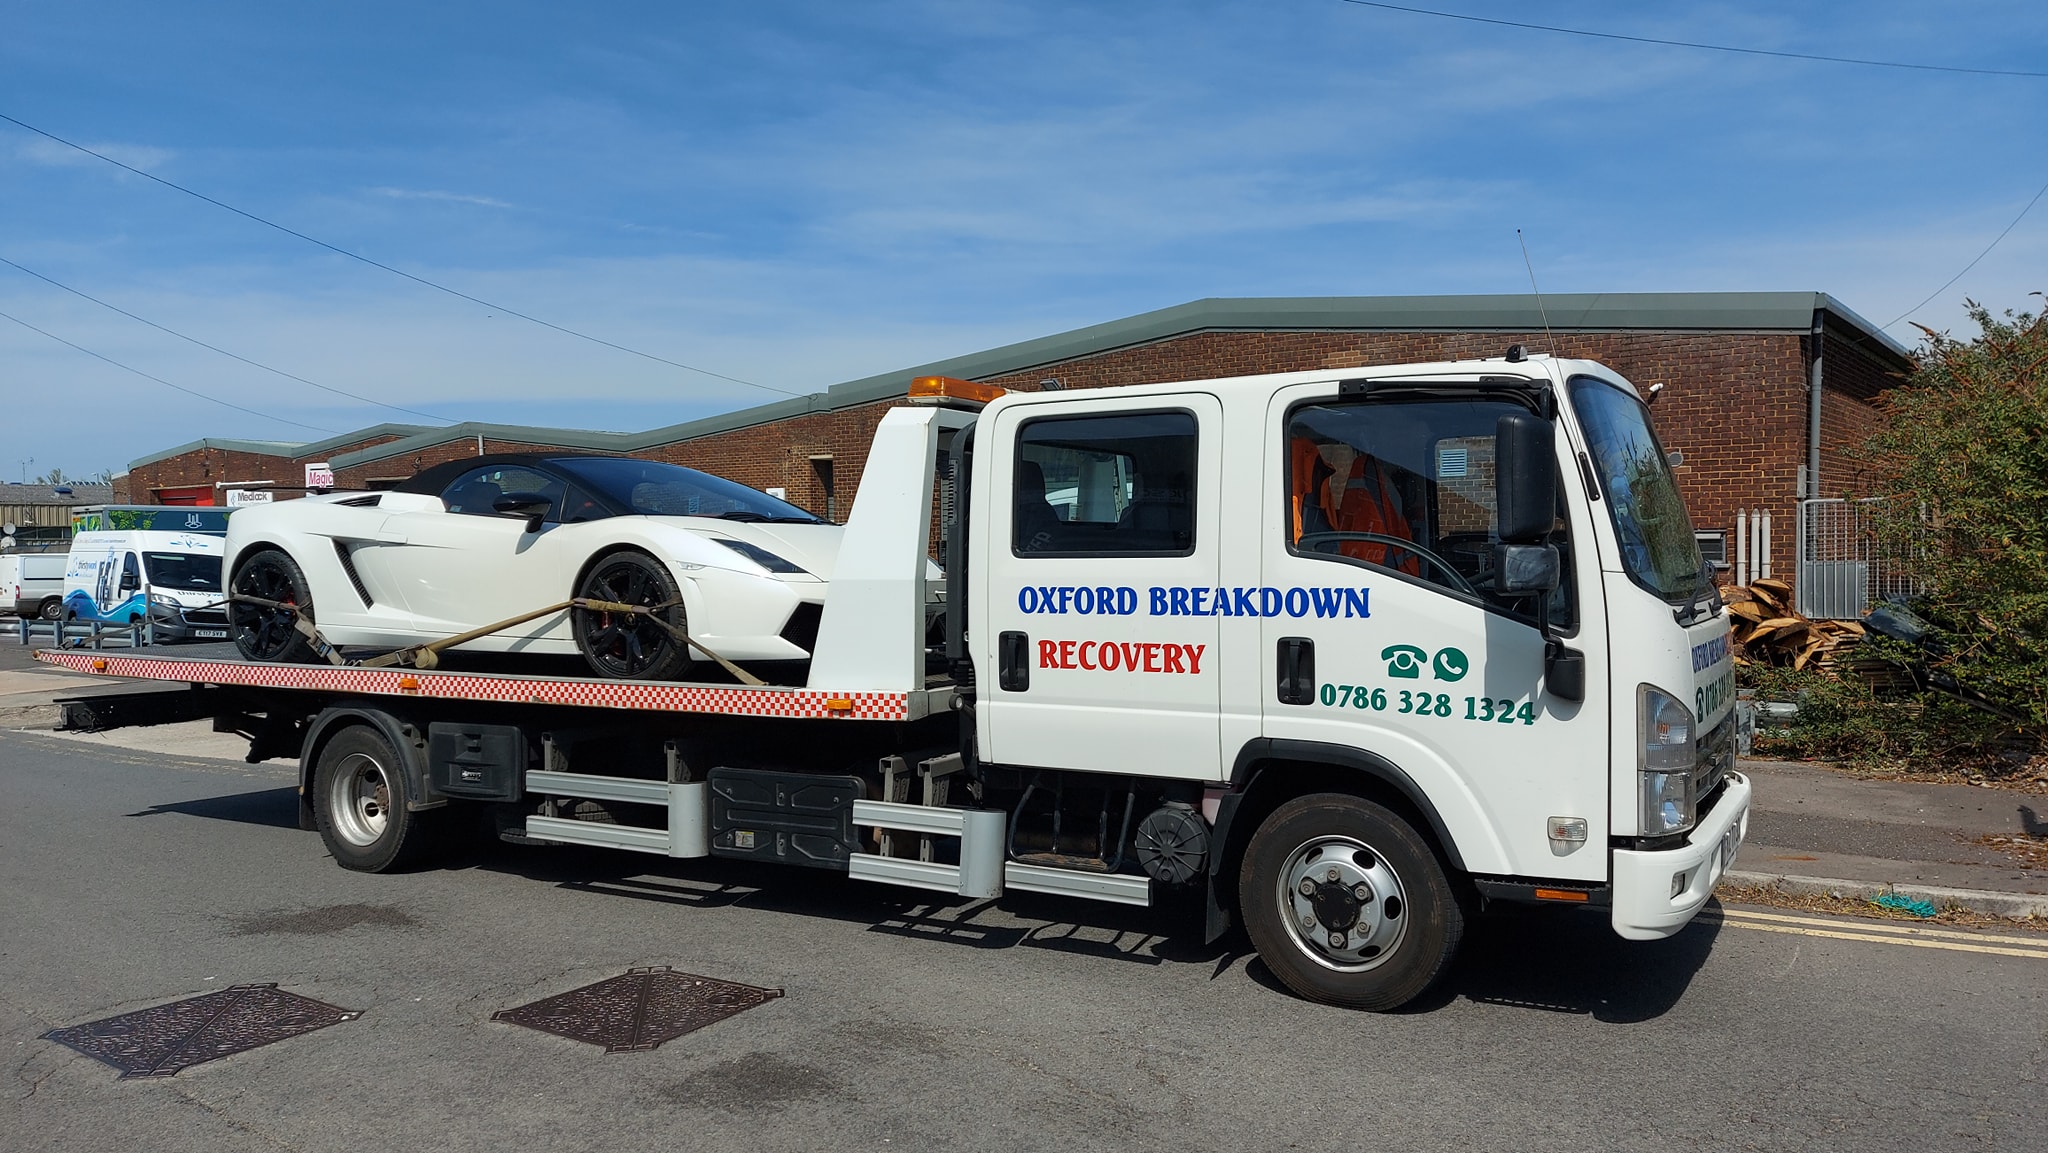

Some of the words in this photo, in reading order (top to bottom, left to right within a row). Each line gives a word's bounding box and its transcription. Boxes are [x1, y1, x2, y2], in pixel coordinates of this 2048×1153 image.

[309, 471, 334, 488] Magic
[237, 492, 267, 502] Medlock
[1017, 586, 1138, 615] OXFORD
[1148, 586, 1371, 619] BREAKDOWN
[1038, 640, 1206, 675] RECOVERY
[1320, 683, 1388, 711] 0786
[1398, 690, 1451, 718] 328
[1464, 696, 1537, 726] 1324
